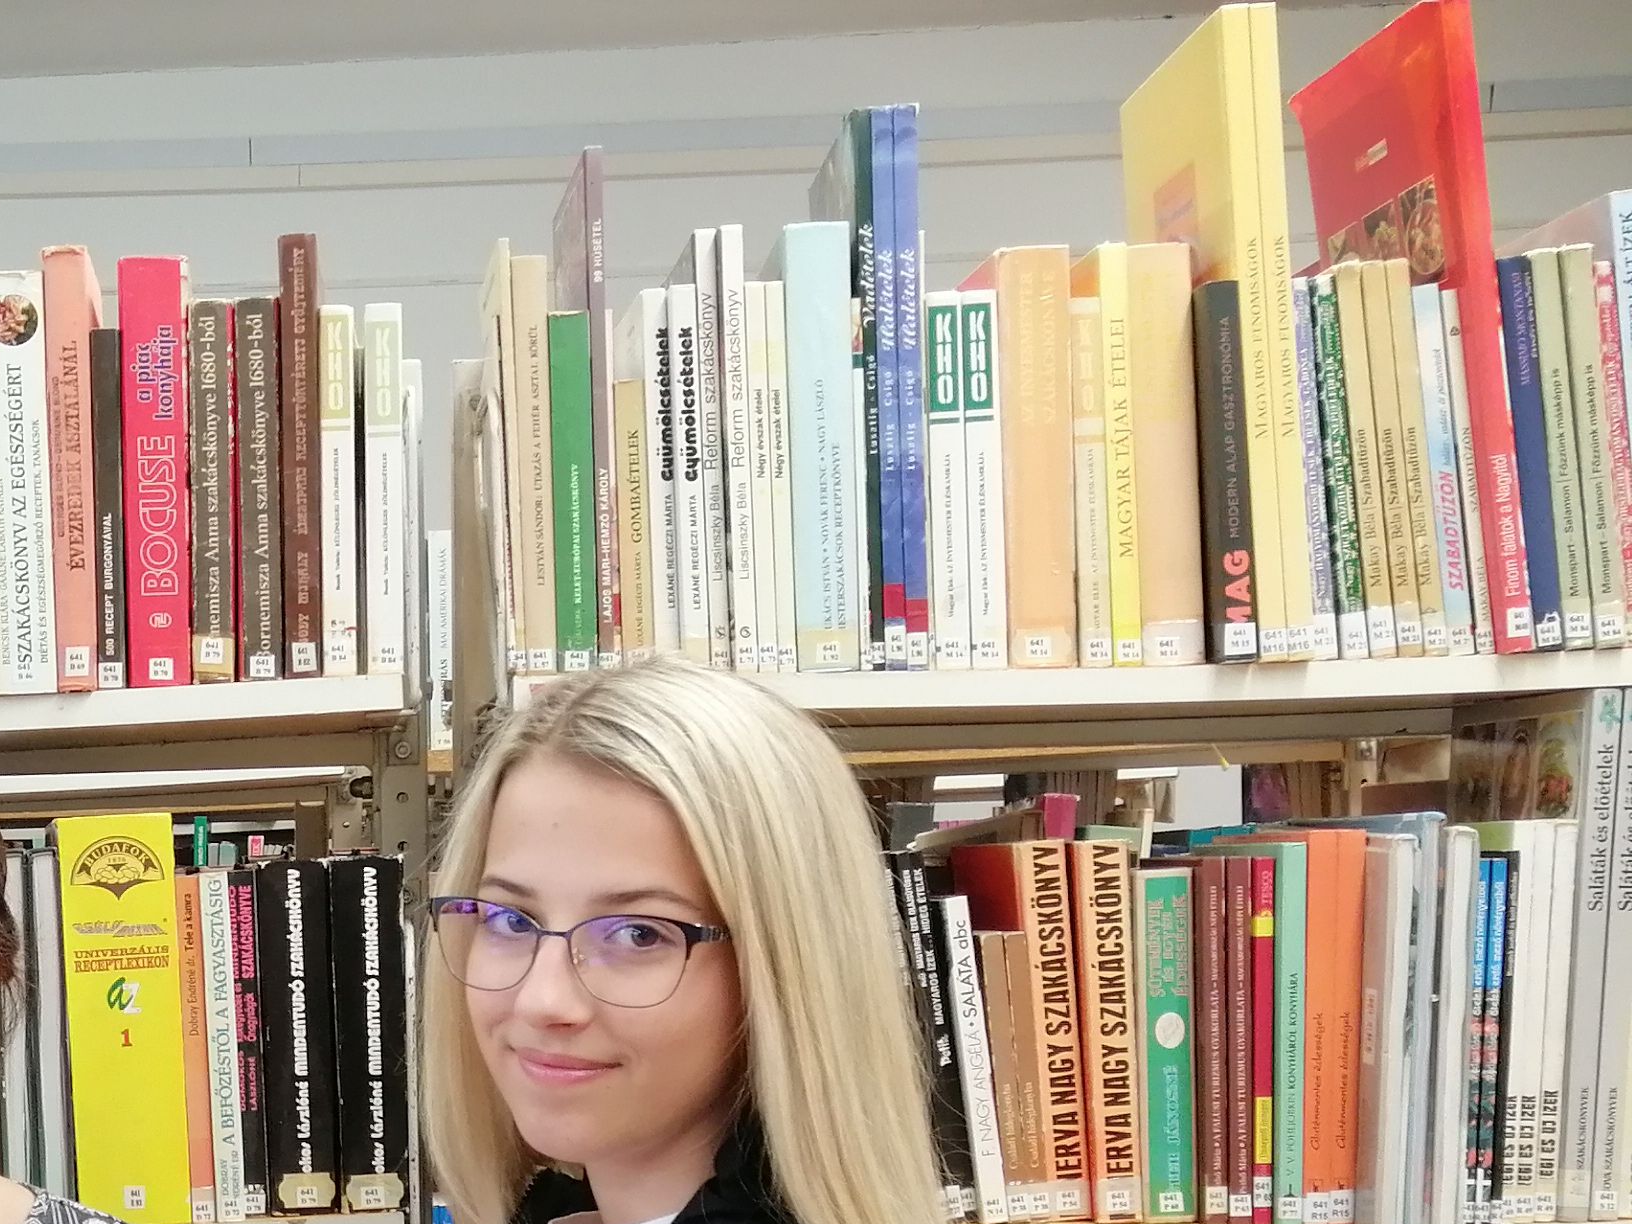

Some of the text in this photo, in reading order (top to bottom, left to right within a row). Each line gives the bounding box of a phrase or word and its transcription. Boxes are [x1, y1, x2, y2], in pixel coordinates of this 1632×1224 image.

[152, 325, 178, 422] konyhája
[678, 327, 698, 482] Gyümölcsételek
[699, 293, 719, 471] Reform szakácskönyv
[726, 290, 747, 468] Reform szakácskönyv
[1252, 350, 1268, 440] MAGYAROS
[1279, 349, 1295, 438] MAGYAROS
[199, 316, 221, 561] Anna szakácskönyve 1680-ból
[249, 391, 269, 561] Anna szakácskönyve
[627, 430, 642, 544] GOMBAÉTELEK
[1108, 318, 1134, 558] MAGYAR TÁJAK ÉTELEI
[1224, 435, 1240, 538] MODERN ALAP
[3, 363, 33, 664] SZAKÁCSKÖNYV EGÉSZSÉGÉRT
[137, 435, 180, 597] BOCUSE
[1496, 515, 1520, 597] Finom falatok
[1564, 485, 1574, 533] Salamon
[1596, 480, 1608, 530] Salamon
[603, 591, 612, 623] LAJOS
[85, 843, 151, 868] BUDAFOK
[1588, 744, 1615, 912] Saláták előételek
[74, 945, 170, 959] UNIVERZÁLIS
[74, 955, 170, 973] RECEPTLEXIKON
[208, 880, 237, 1130] BEFŐZÉSTŐL FAGYASZTÁSIG
[929, 973, 944, 1025] MAGYAROS
[1031, 847, 1076, 1106] NAGY SZAKÁCSKÖNYV
[1090, 845, 1131, 1107] NAGY SZAKÁCSKÖNYV
[121, 1028, 133, 1047] 1
[953, 920, 994, 1146] NAGY ANGÉLA SALÁTA abc
[1287, 973, 1298, 1089] KONYHÁRÓL KONYHÁRA
